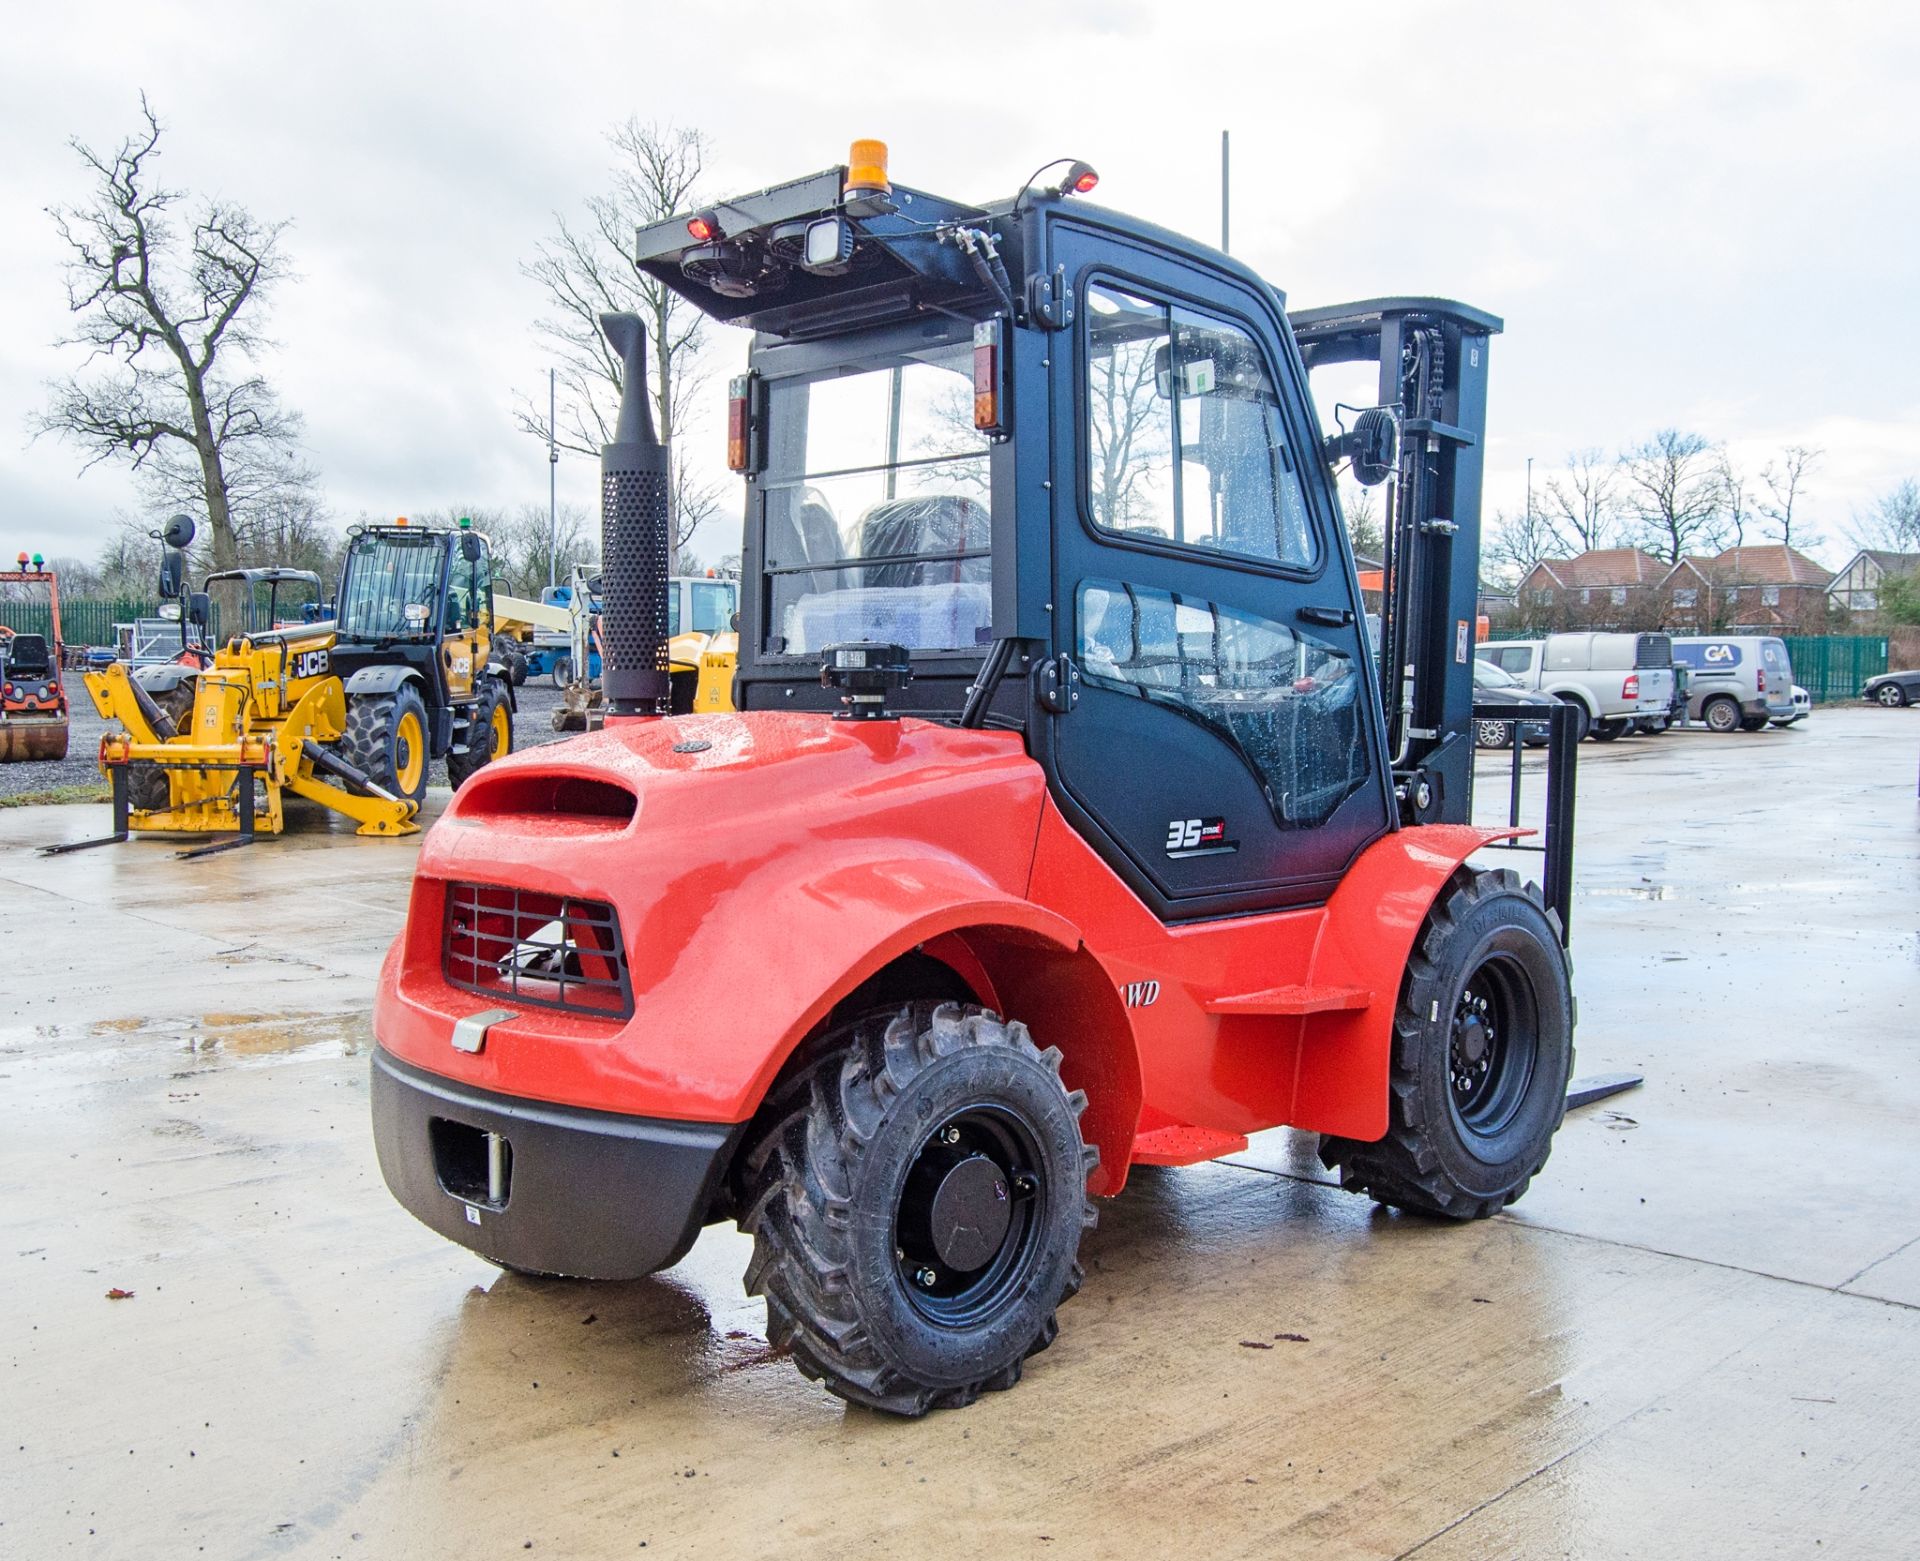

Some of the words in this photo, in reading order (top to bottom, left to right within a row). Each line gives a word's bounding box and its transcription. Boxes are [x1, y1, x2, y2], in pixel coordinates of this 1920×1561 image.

[297, 650, 329, 678] JCB
[452, 657, 470, 674] JCB
[1704, 645, 1735, 662] GA
[1165, 819, 1203, 849] 35
[1119, 980, 1161, 1008] WD
